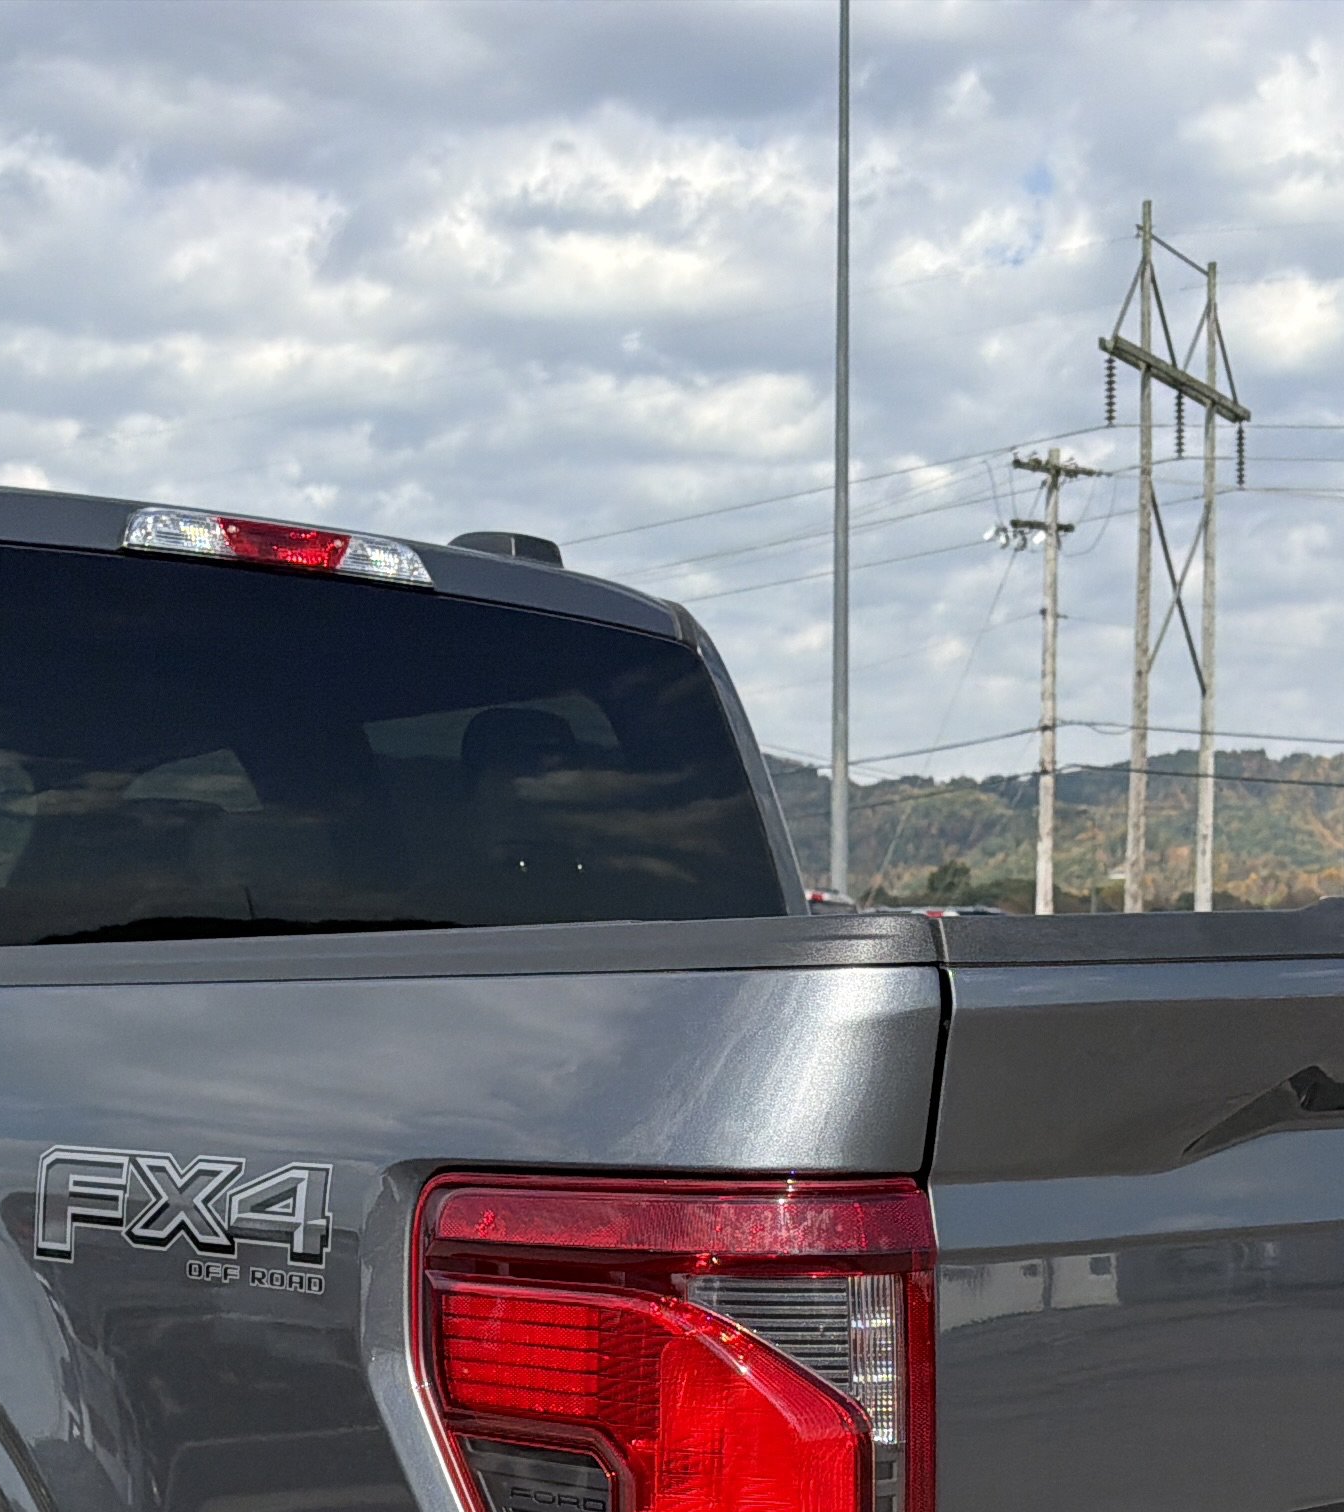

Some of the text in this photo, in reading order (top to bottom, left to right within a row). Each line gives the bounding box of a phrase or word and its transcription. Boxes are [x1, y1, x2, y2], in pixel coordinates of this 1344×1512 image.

[34, 1144, 333, 1269] FX4
[186, 1260, 325, 1294] OFF ROAD
[510, 1486, 607, 1512] FORD
